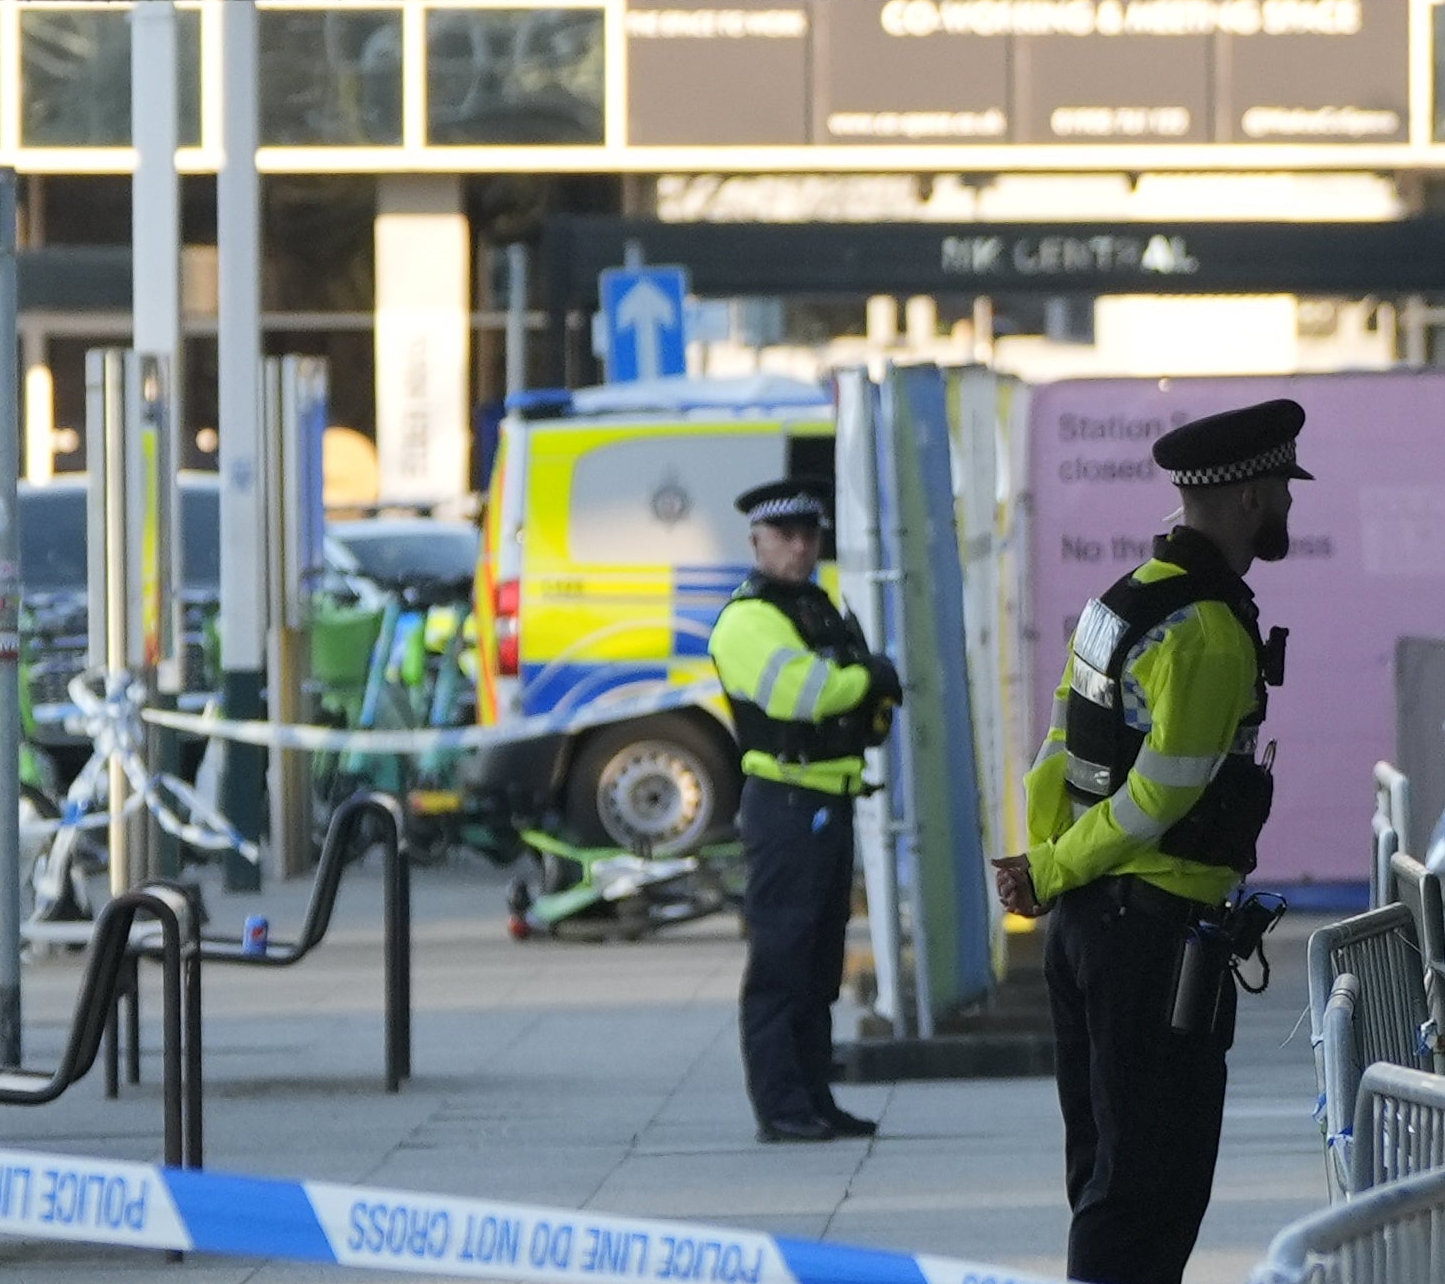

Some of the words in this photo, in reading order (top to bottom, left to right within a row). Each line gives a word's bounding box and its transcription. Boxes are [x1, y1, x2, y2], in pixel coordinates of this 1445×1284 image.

[1059, 413, 1161, 442] Station
[39, 1168, 152, 1233] POLICE
[346, 1201, 451, 1259] CROSS
[457, 1213, 521, 1267] NOT
[528, 1221, 574, 1271] DO
[582, 1227, 651, 1278] LINE
